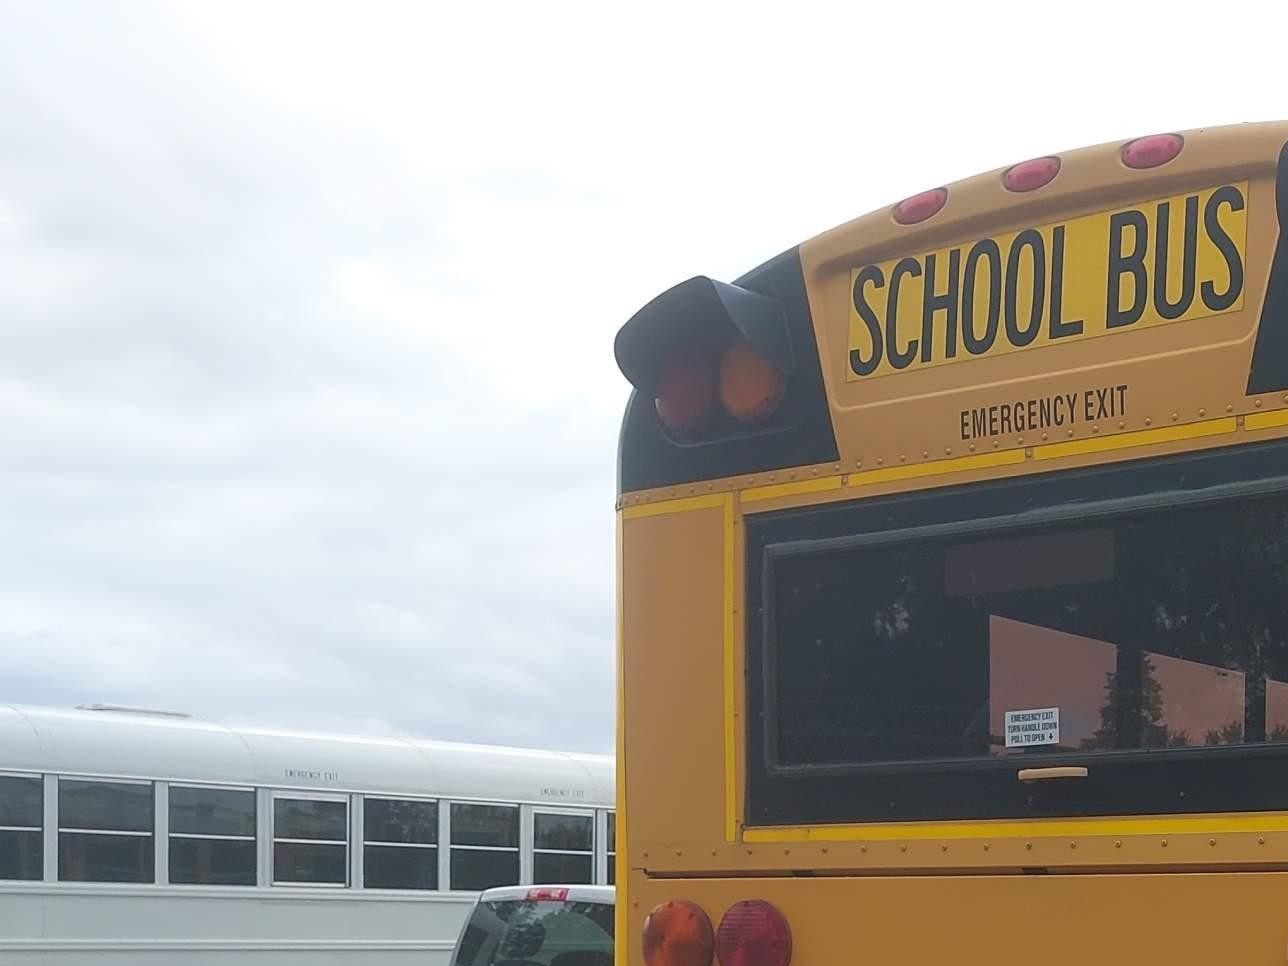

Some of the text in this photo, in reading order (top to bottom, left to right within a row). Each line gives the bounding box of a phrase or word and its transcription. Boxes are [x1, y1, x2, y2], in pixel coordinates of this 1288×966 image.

[849, 185, 1245, 376] SCHOOL BUS
[960, 384, 1128, 440] EMERGENCY EXIT
[1011, 712, 1053, 722] EMERGENCY EXIT
[1008, 725, 1021, 733] TURN
[1024, 734, 1031, 742] TO
